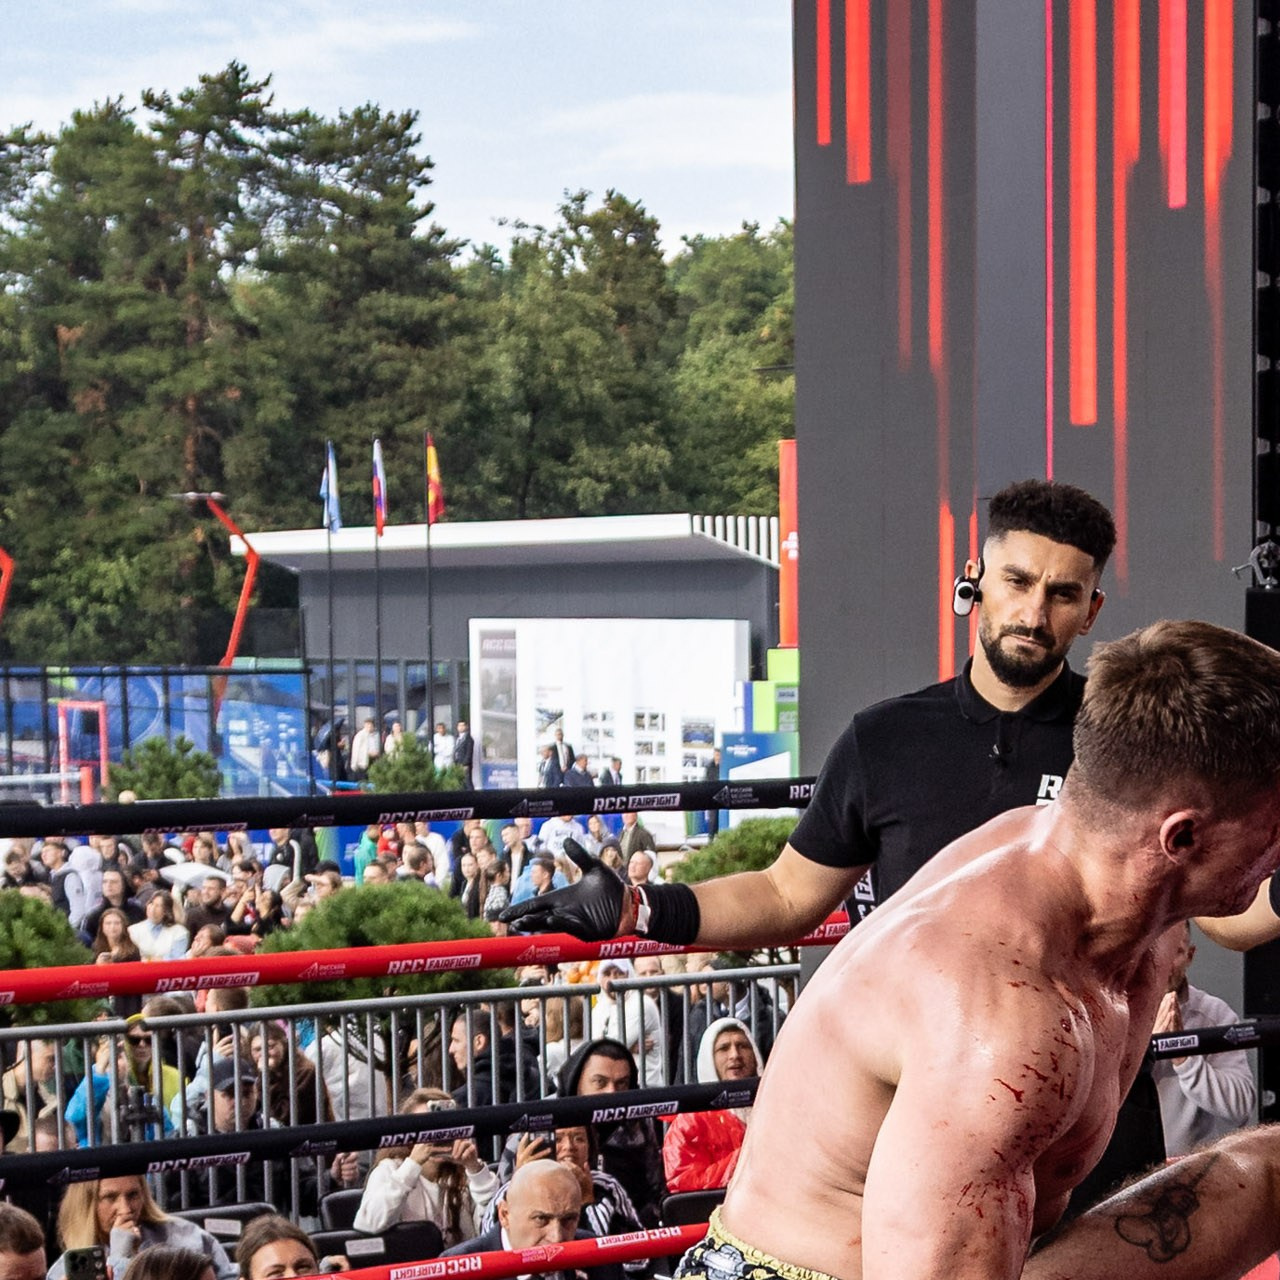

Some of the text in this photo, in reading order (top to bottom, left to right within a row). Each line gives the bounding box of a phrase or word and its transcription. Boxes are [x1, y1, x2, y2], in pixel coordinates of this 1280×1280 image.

[593, 793, 680, 811] RCC FAIRFIGHT
[378, 808, 473, 824] RCC FAIRFIGHT
[600, 942, 633, 957] RCC
[387, 955, 481, 974] RCC FAIRFIGHT
[155, 973, 258, 992] RCC FAIRFIGHT
[1159, 1036, 1198, 1051] FAIRFIGHT
[591, 1102, 678, 1123] RCC FAIRFIGHT
[379, 1126, 474, 1147] RCC FAIRFIGHT
[648, 1226, 682, 1241] RCC
[448, 1256, 481, 1275] RCC
